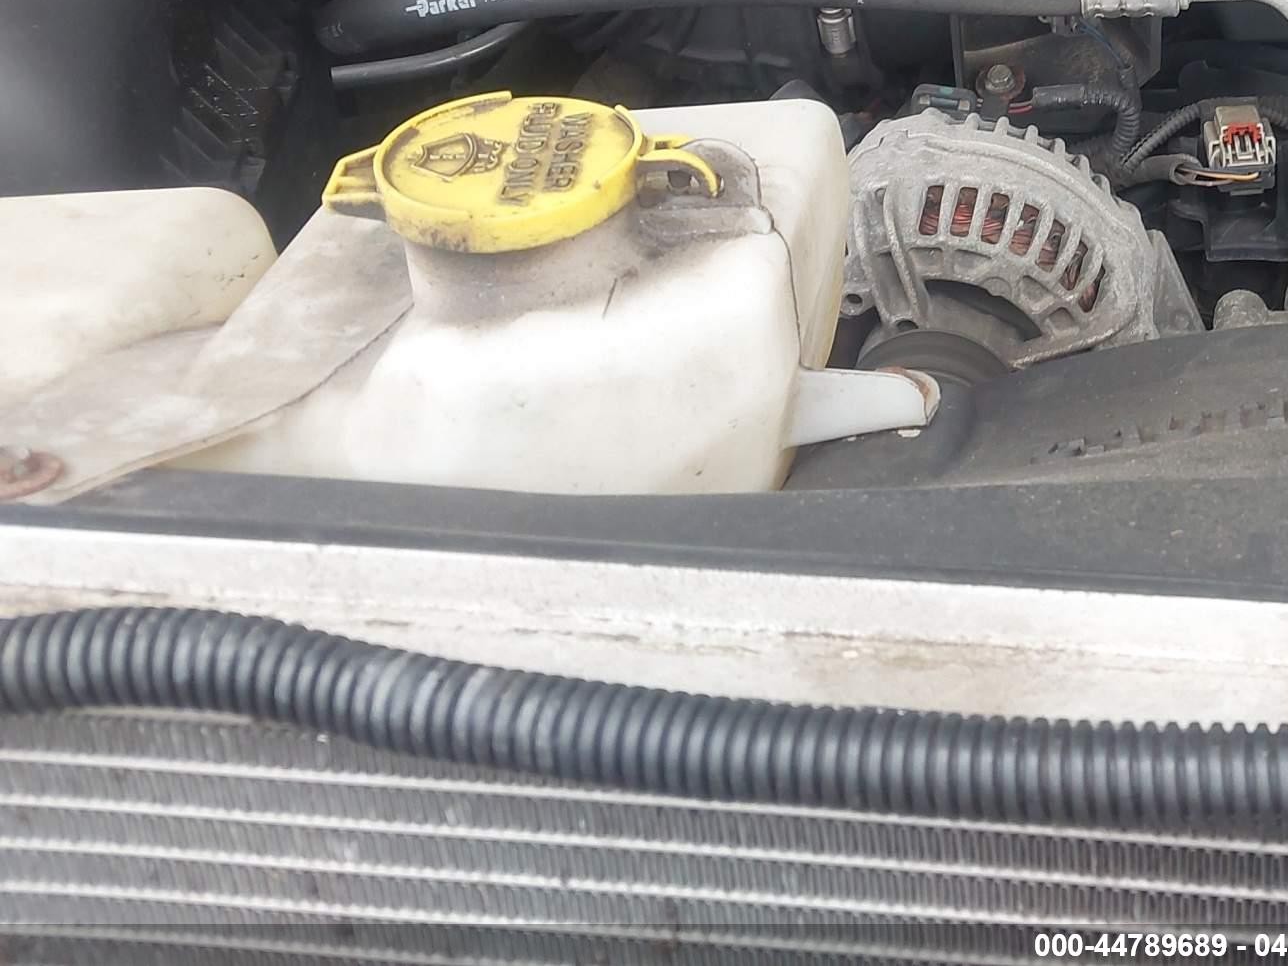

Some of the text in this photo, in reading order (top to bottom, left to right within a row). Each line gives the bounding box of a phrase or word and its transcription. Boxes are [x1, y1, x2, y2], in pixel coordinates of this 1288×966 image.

[497, 101, 561, 207] FLUID ONLY
[544, 112, 593, 192] WASHER
